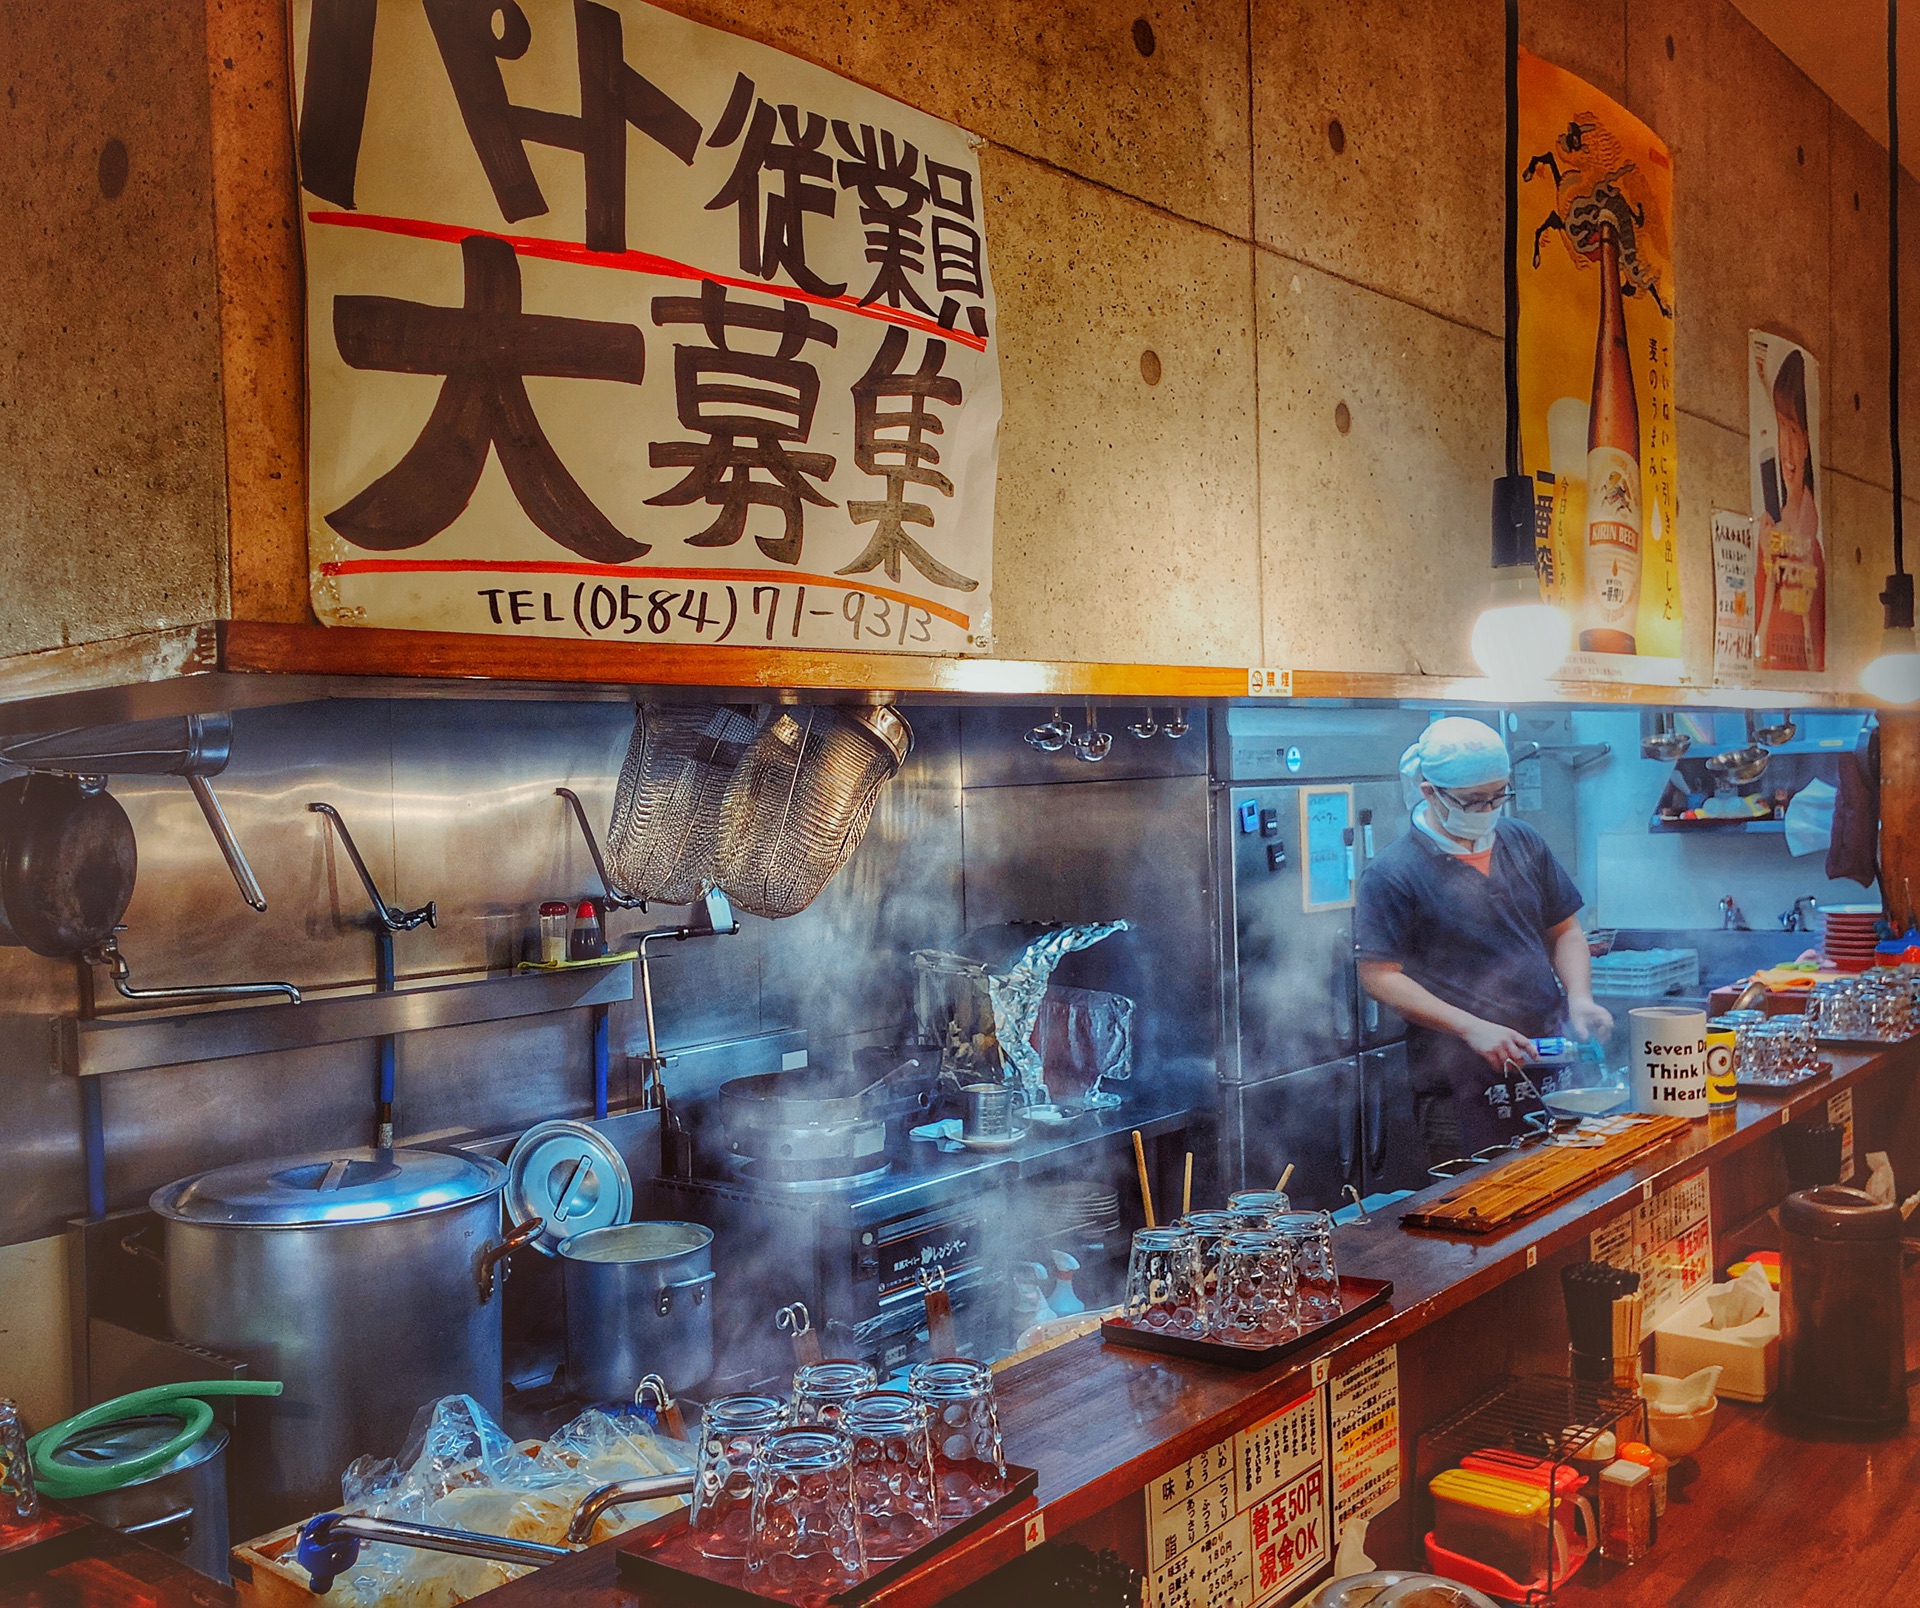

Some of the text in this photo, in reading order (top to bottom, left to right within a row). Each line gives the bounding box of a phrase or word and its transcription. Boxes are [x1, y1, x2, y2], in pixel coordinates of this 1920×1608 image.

[324, 235, 980, 592] 大募集
[1591, 523, 1617, 541] KIRIN
[1266, 671, 1290, 688] 禁煙
[1644, 1040, 1693, 1056] Seven
[1646, 1063, 1699, 1080] Think
[1652, 1085, 1658, 1100] I
[1316, 1364, 1324, 1381] 5
[1162, 1477, 1176, 1501] 味
[1219, 1476, 1229, 1522] こってり
[1186, 1499, 1196, 1544] あっさり
[1202, 1499, 1211, 1534] ふつう
[1253, 1471, 1321, 1551] 替玉50円
[1026, 1522, 1039, 1542] 4
[1165, 1534, 1177, 1561] 脂
[1208, 1540, 1233, 1564] 180円
[1259, 1517, 1319, 1590] 現金OK
[1167, 1556, 1188, 1578] 味玉子
[1208, 1569, 1234, 1595] 250円
